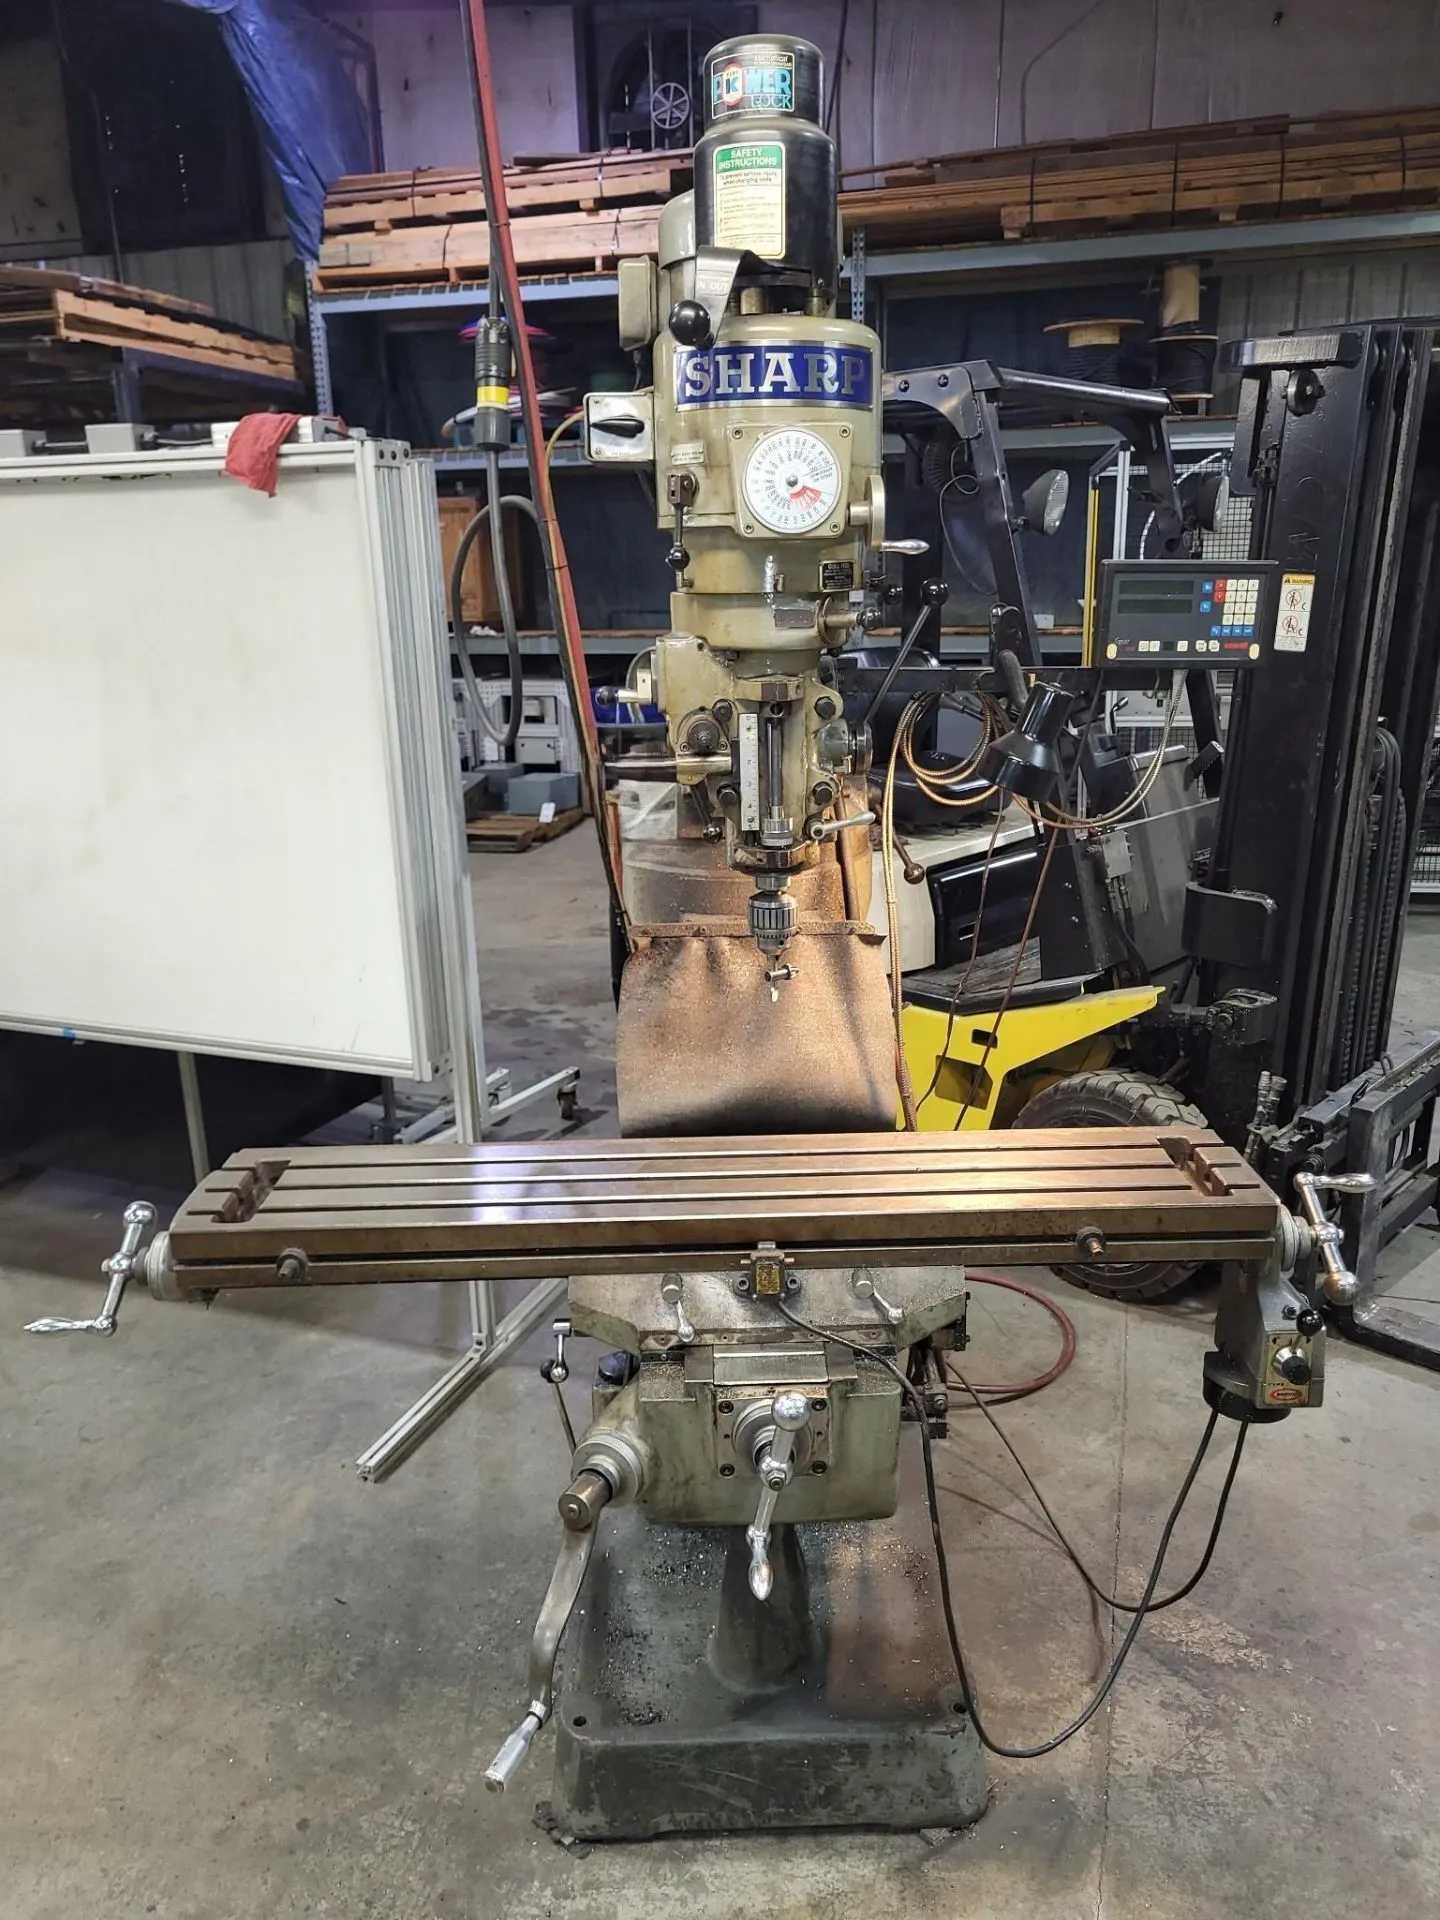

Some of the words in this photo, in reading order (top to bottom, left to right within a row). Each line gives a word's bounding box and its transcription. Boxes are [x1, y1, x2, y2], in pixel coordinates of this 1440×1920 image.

[730, 148, 762, 158] SAFETY
[718, 157, 777, 170] INSTRUCTIONS
[685, 352, 865, 397] SHARP
